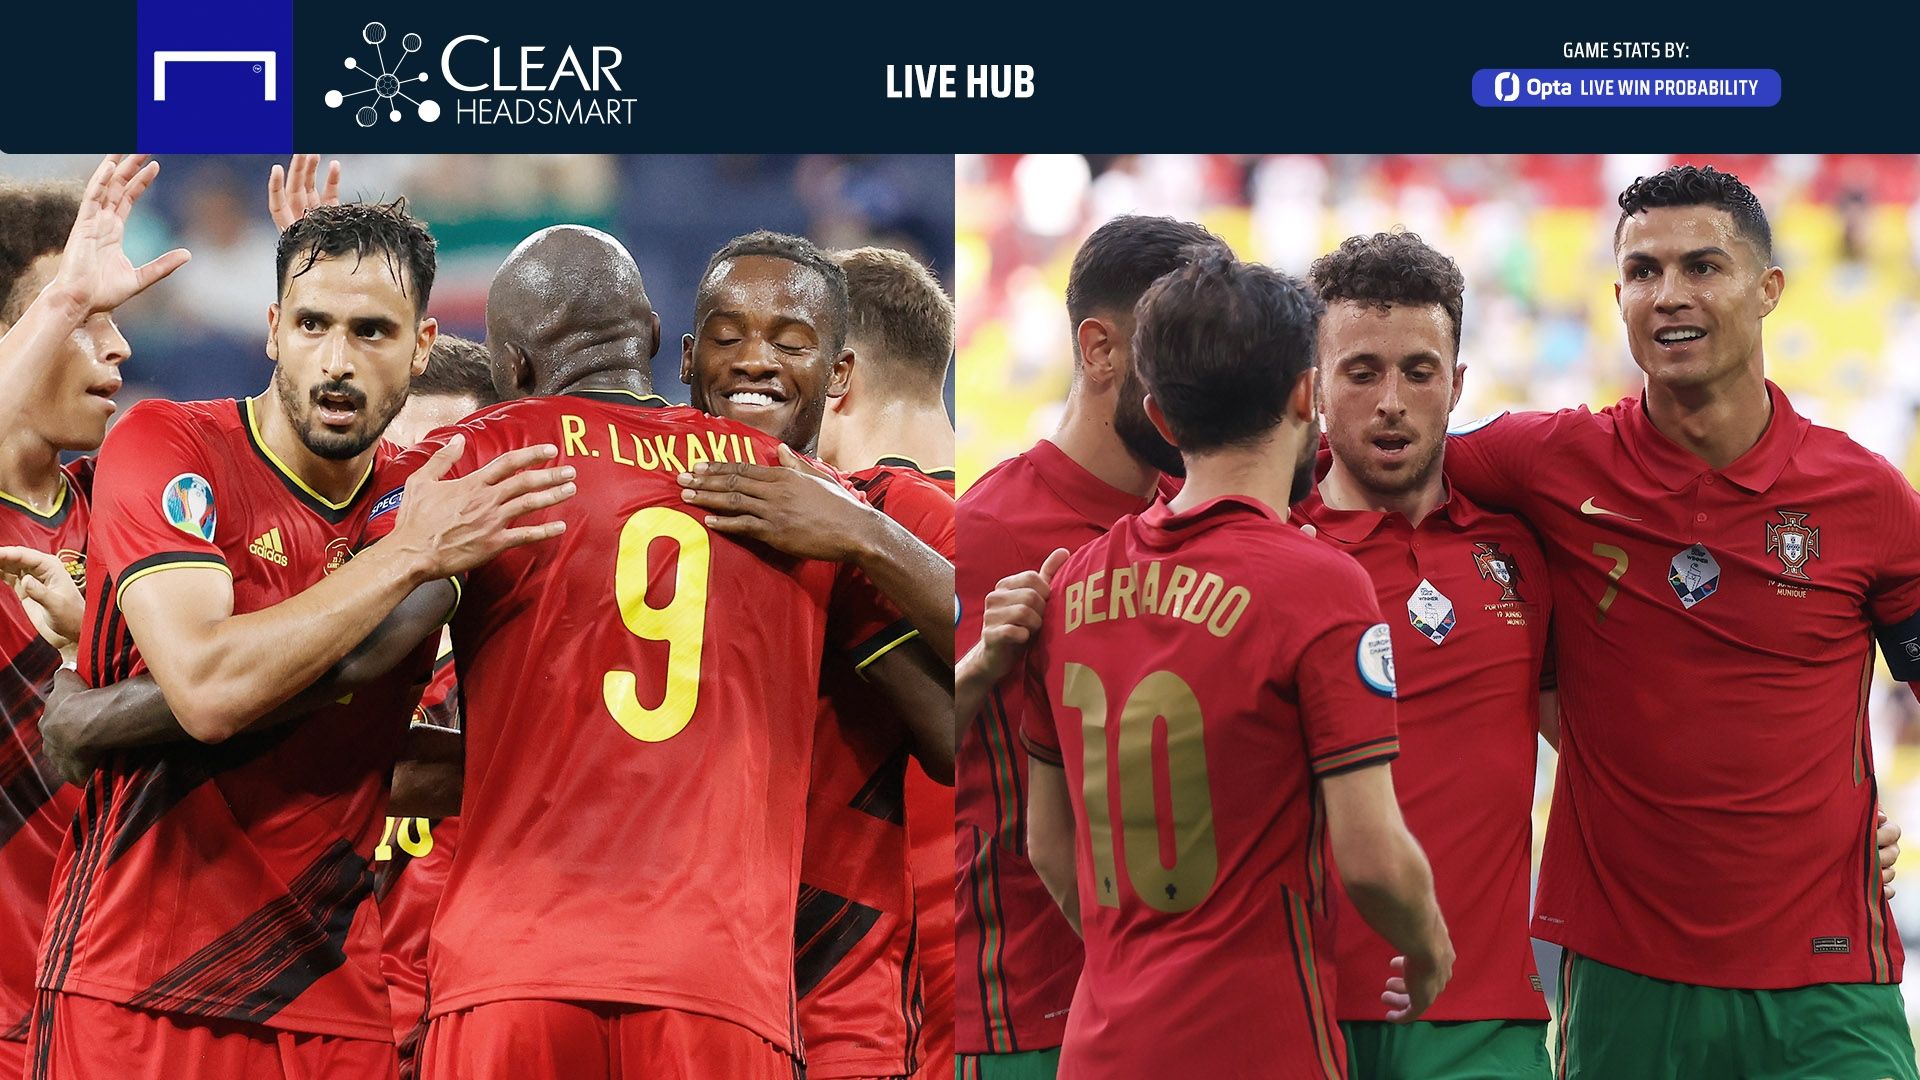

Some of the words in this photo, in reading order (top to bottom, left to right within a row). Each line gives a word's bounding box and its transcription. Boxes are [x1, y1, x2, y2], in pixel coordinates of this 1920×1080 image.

[561, 414, 601, 458] R.
[249, 543, 288, 566] adidas
[1592, 542, 1629, 624] 7
[602, 506, 711, 743] 9
[1062, 661, 1218, 914] 10
